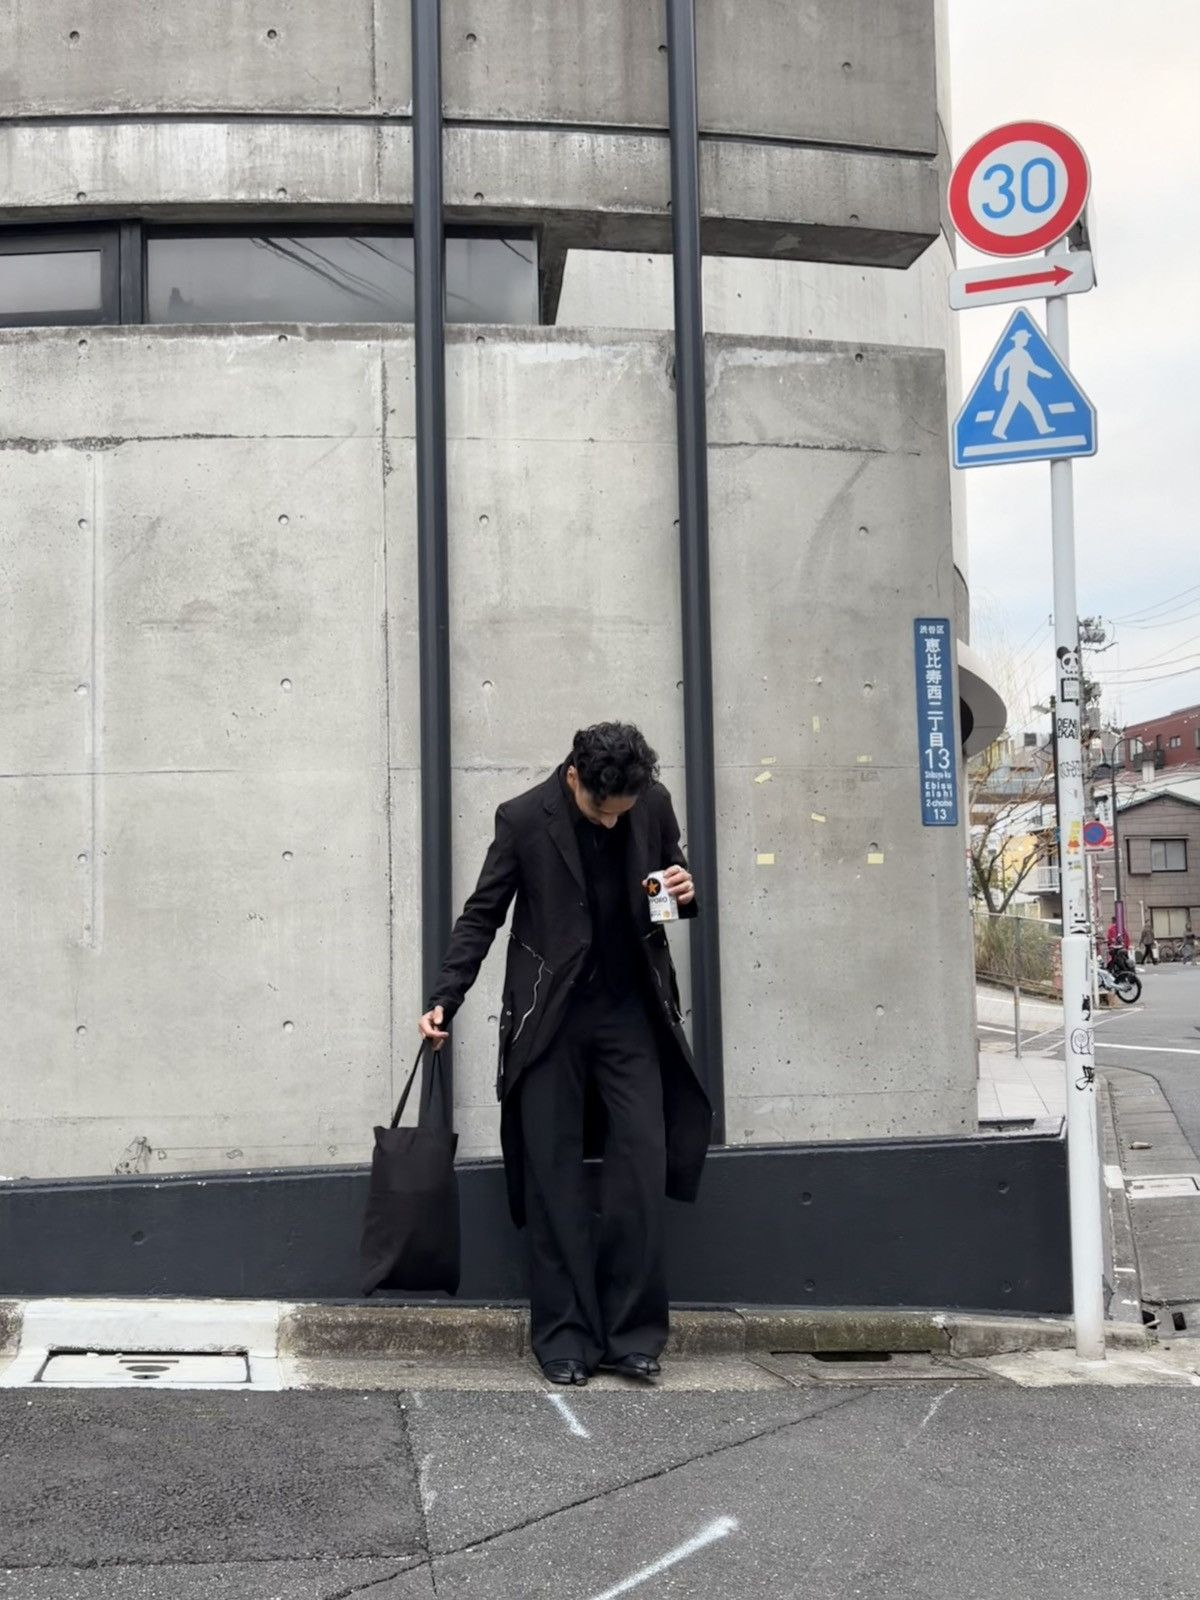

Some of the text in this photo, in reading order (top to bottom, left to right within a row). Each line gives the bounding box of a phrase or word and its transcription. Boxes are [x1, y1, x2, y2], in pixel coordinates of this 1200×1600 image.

[982, 157, 1056, 219] 30
[924, 638, 944, 748] 恵比寿西二丁目
[925, 748, 950, 769] 13
[925, 781, 952, 790] Ebisu
[925, 790, 953, 798] nishi
[934, 808, 947, 820] 13
